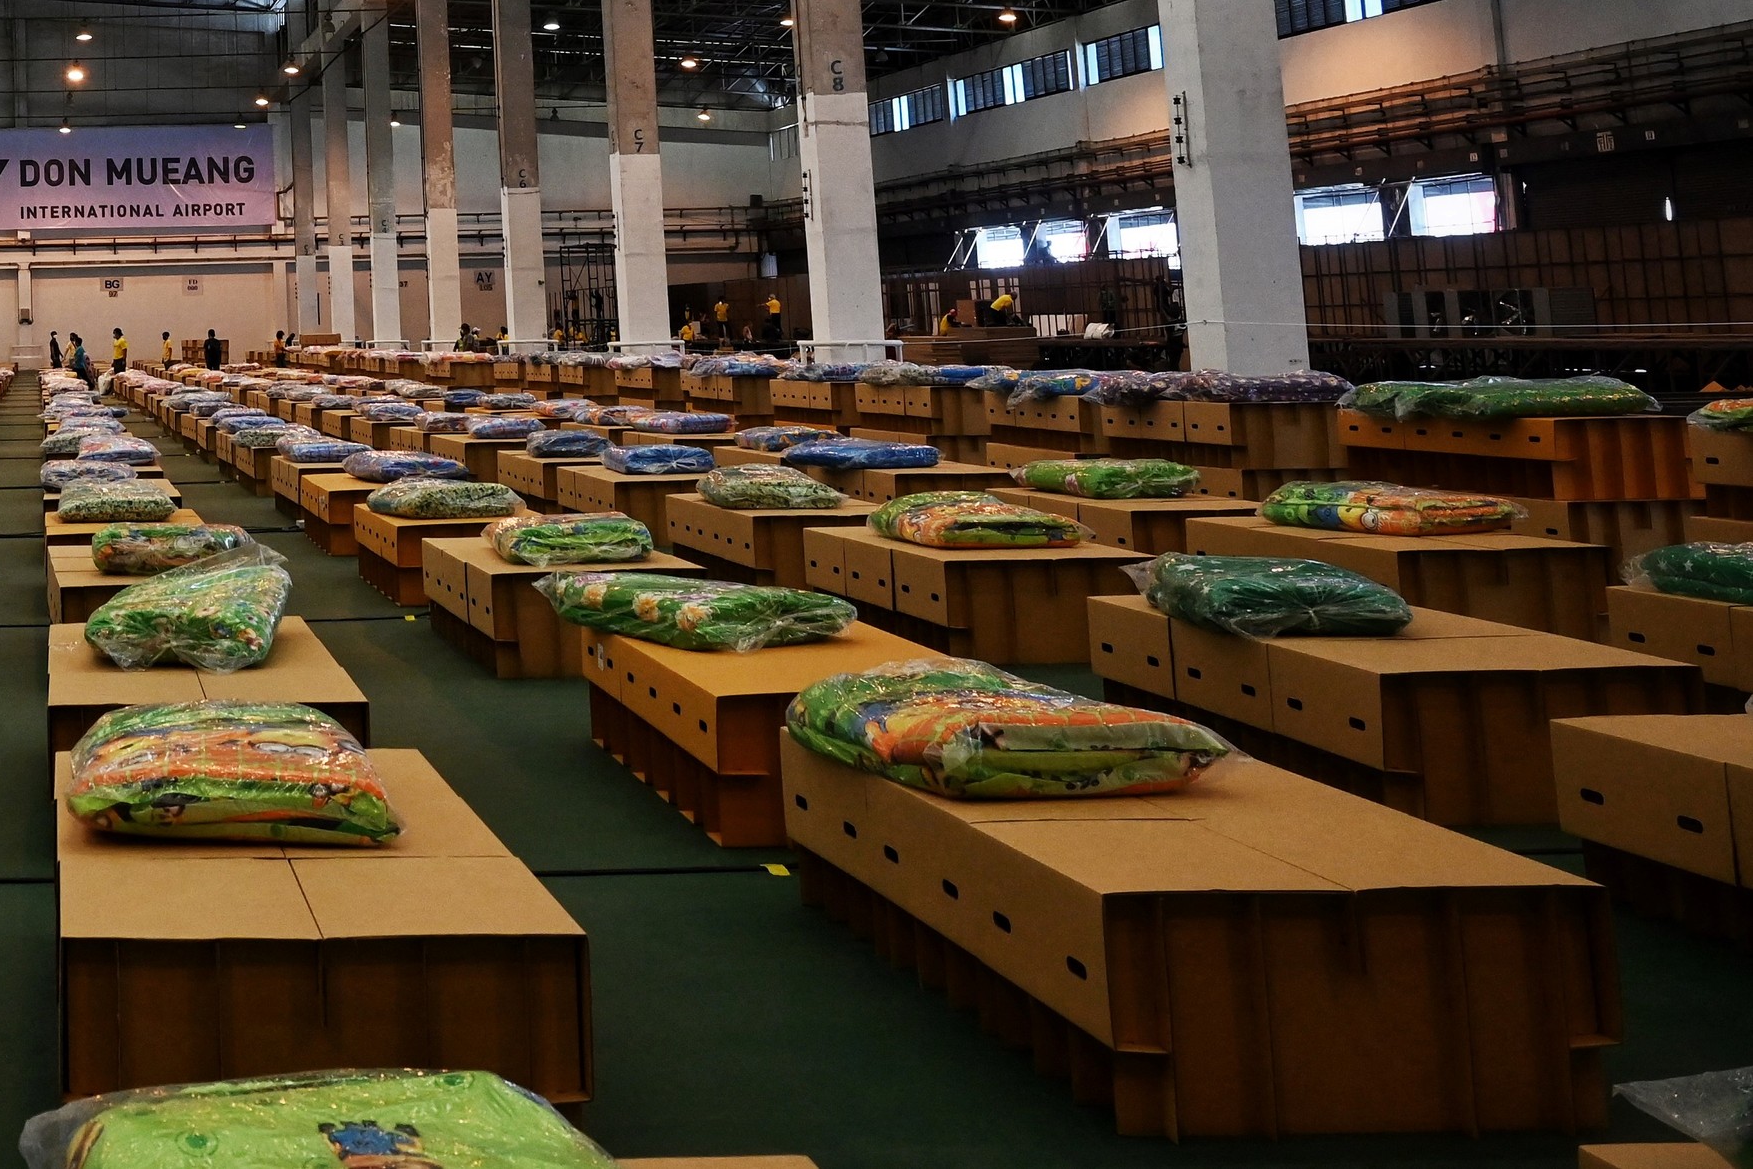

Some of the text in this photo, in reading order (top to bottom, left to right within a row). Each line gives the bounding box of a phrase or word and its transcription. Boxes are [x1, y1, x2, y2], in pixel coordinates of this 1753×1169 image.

[831, 60, 842, 74] C
[634, 129, 643, 140] C
[634, 142, 643, 152] 7
[19, 159, 91, 187] DON
[106, 156, 254, 186] MUEANG
[519, 169, 527, 178] C
[519, 180, 527, 188] 6
[20, 203, 246, 220] INTERNATIONAL AIRPORT
[476, 272, 492, 283] AY
[104, 280, 120, 289] BG
